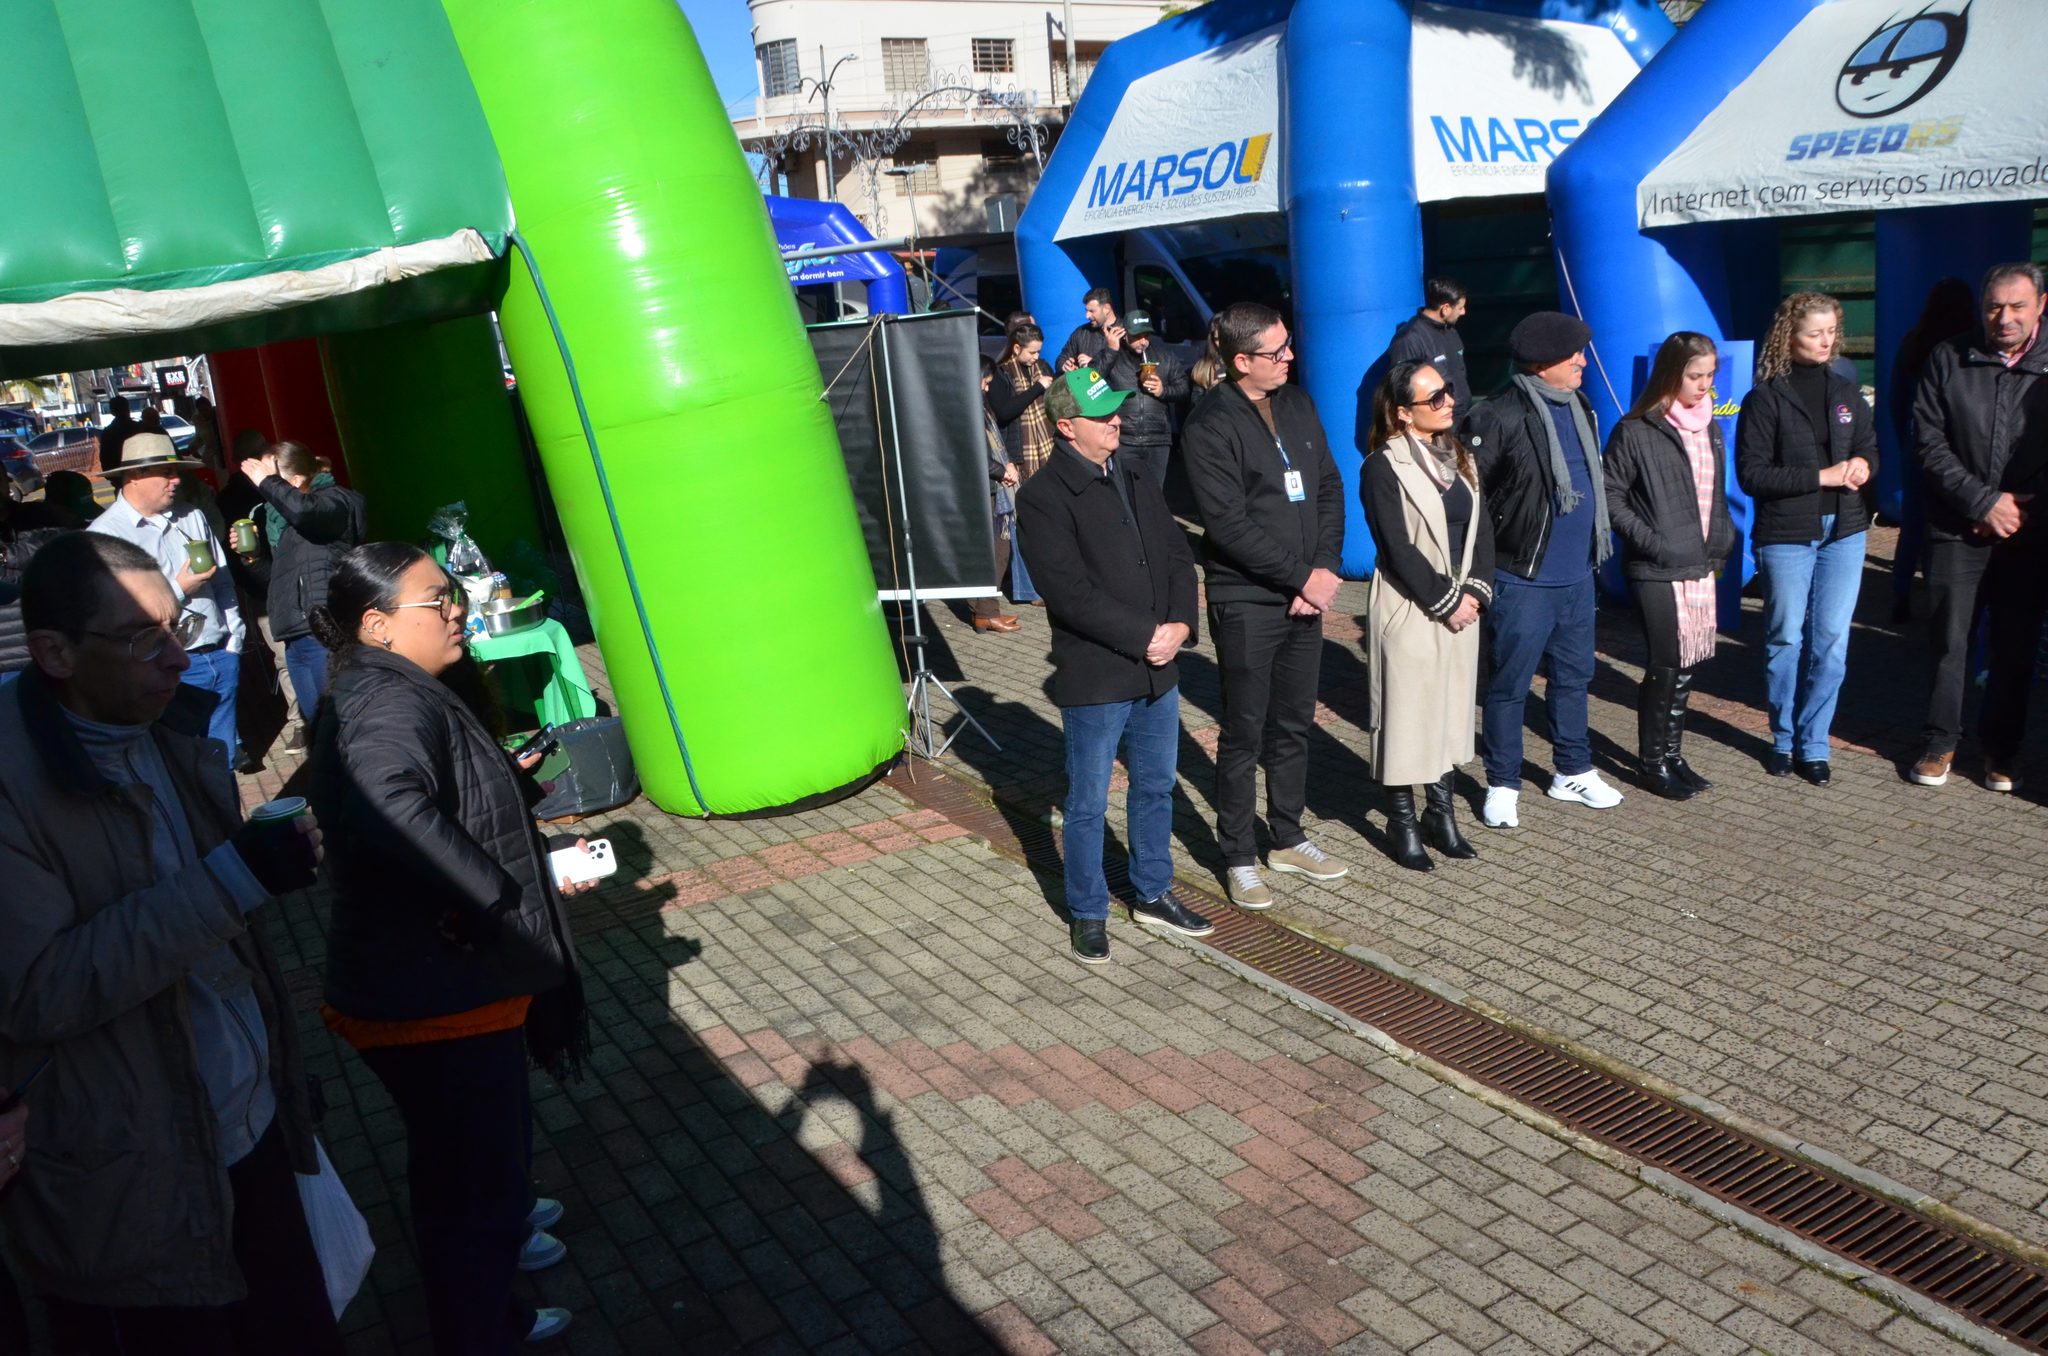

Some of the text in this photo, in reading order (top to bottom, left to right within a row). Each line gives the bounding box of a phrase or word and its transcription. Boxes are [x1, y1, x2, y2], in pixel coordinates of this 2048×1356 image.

[1429, 115, 1600, 162] MARS
[1087, 137, 1254, 209] MARSOL
[1652, 184, 1750, 215] Internet
[1758, 184, 1807, 205] com
[1815, 171, 1929, 203] serviços
[800, 271, 826, 281] dormir
[827, 270, 845, 278] bem
